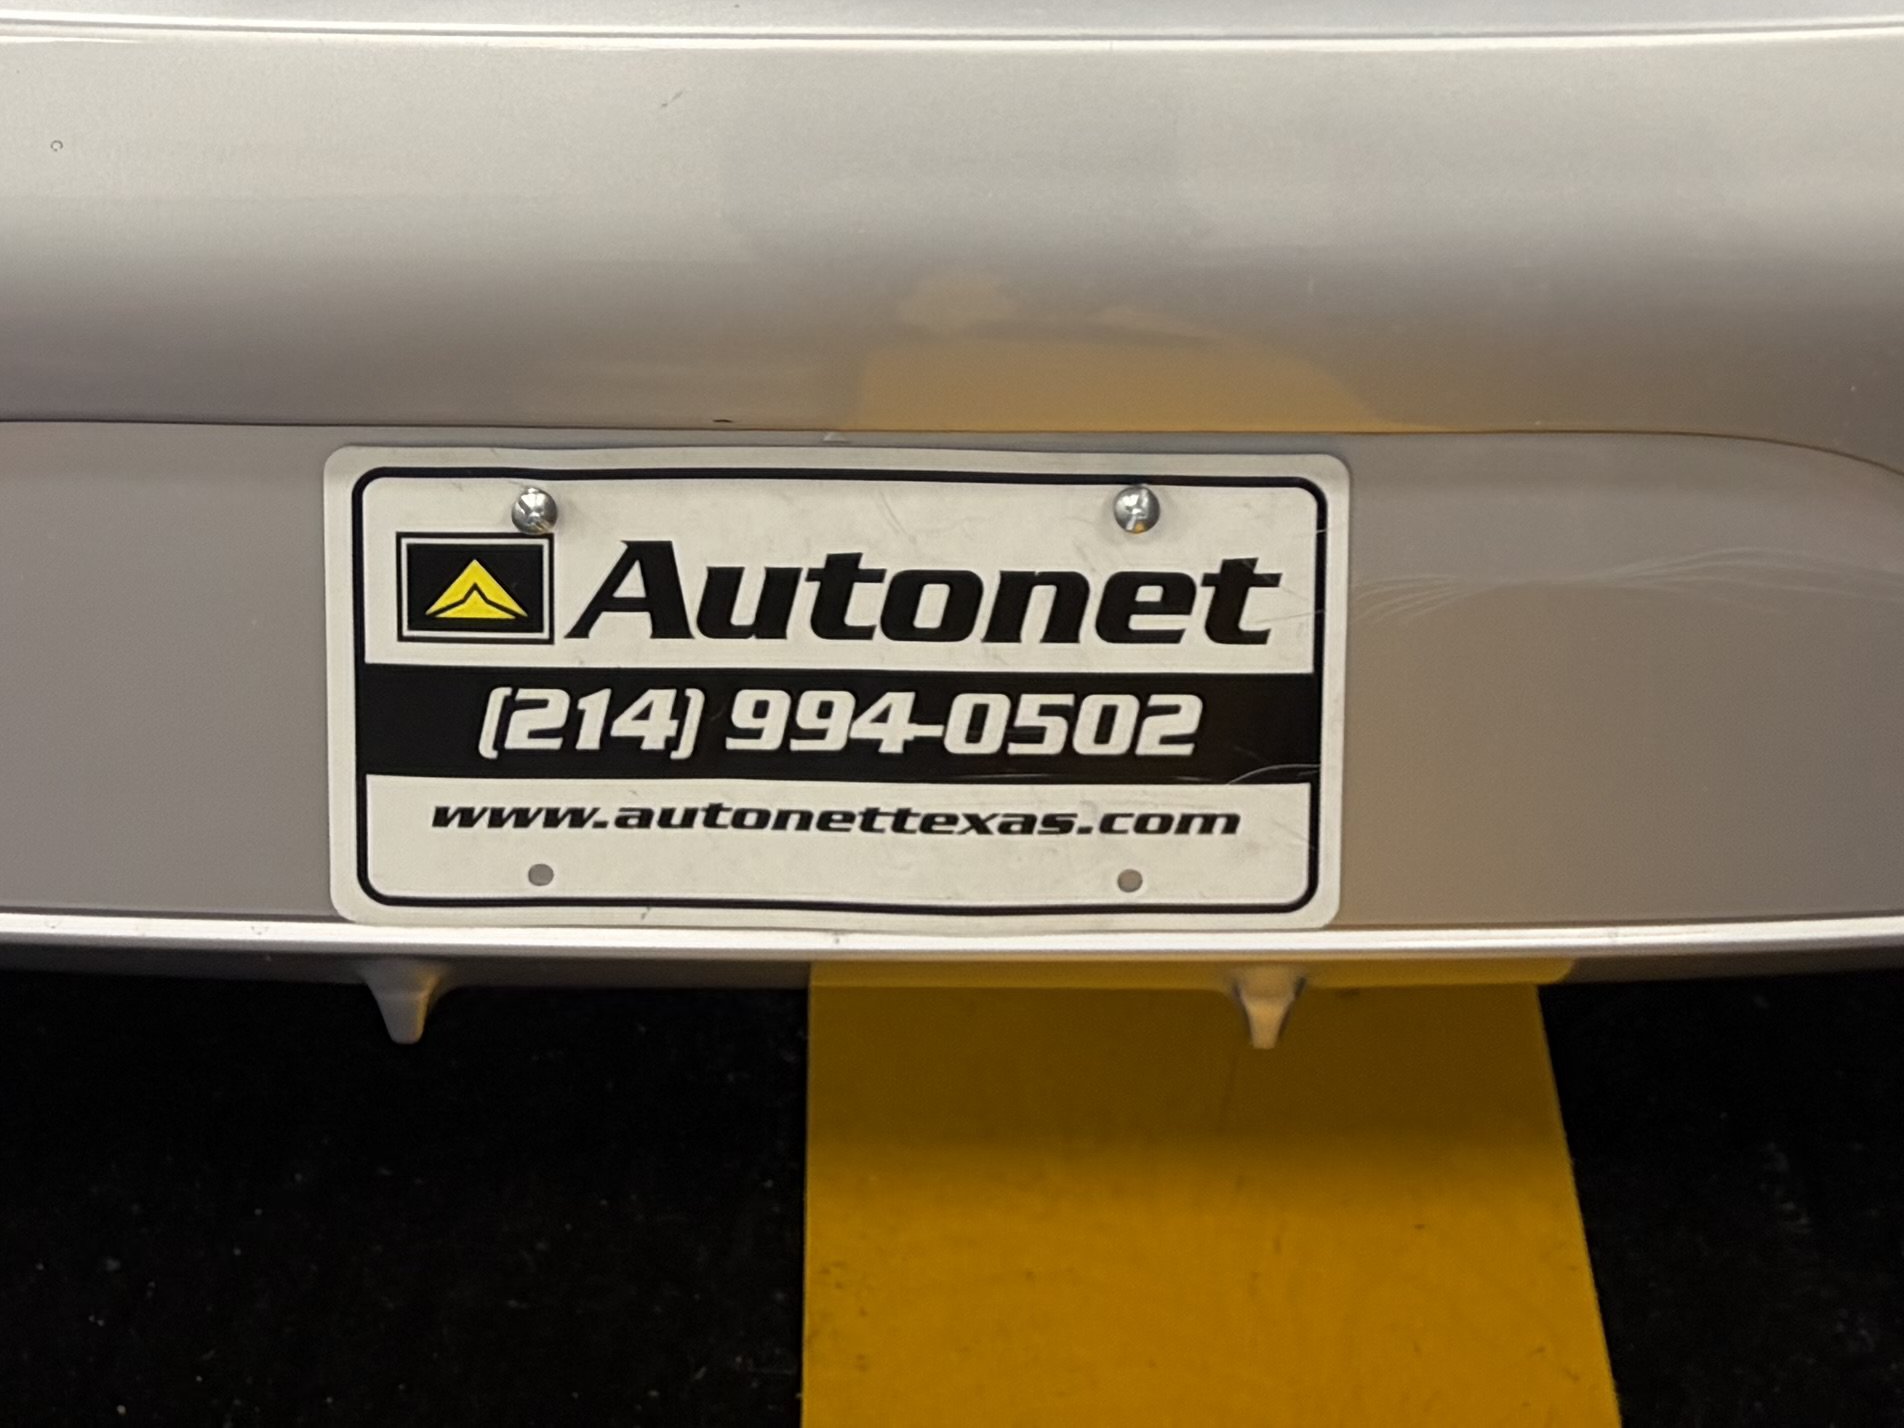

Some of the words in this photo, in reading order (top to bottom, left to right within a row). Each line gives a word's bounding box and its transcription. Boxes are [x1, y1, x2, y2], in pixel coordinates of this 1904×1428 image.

[565, 539, 1282, 645] Autonet
[478, 687, 703, 760] (214)
[724, 691, 1204, 757] 994-0502
[431, 800, 1241, 836] www.autonettexas.com
